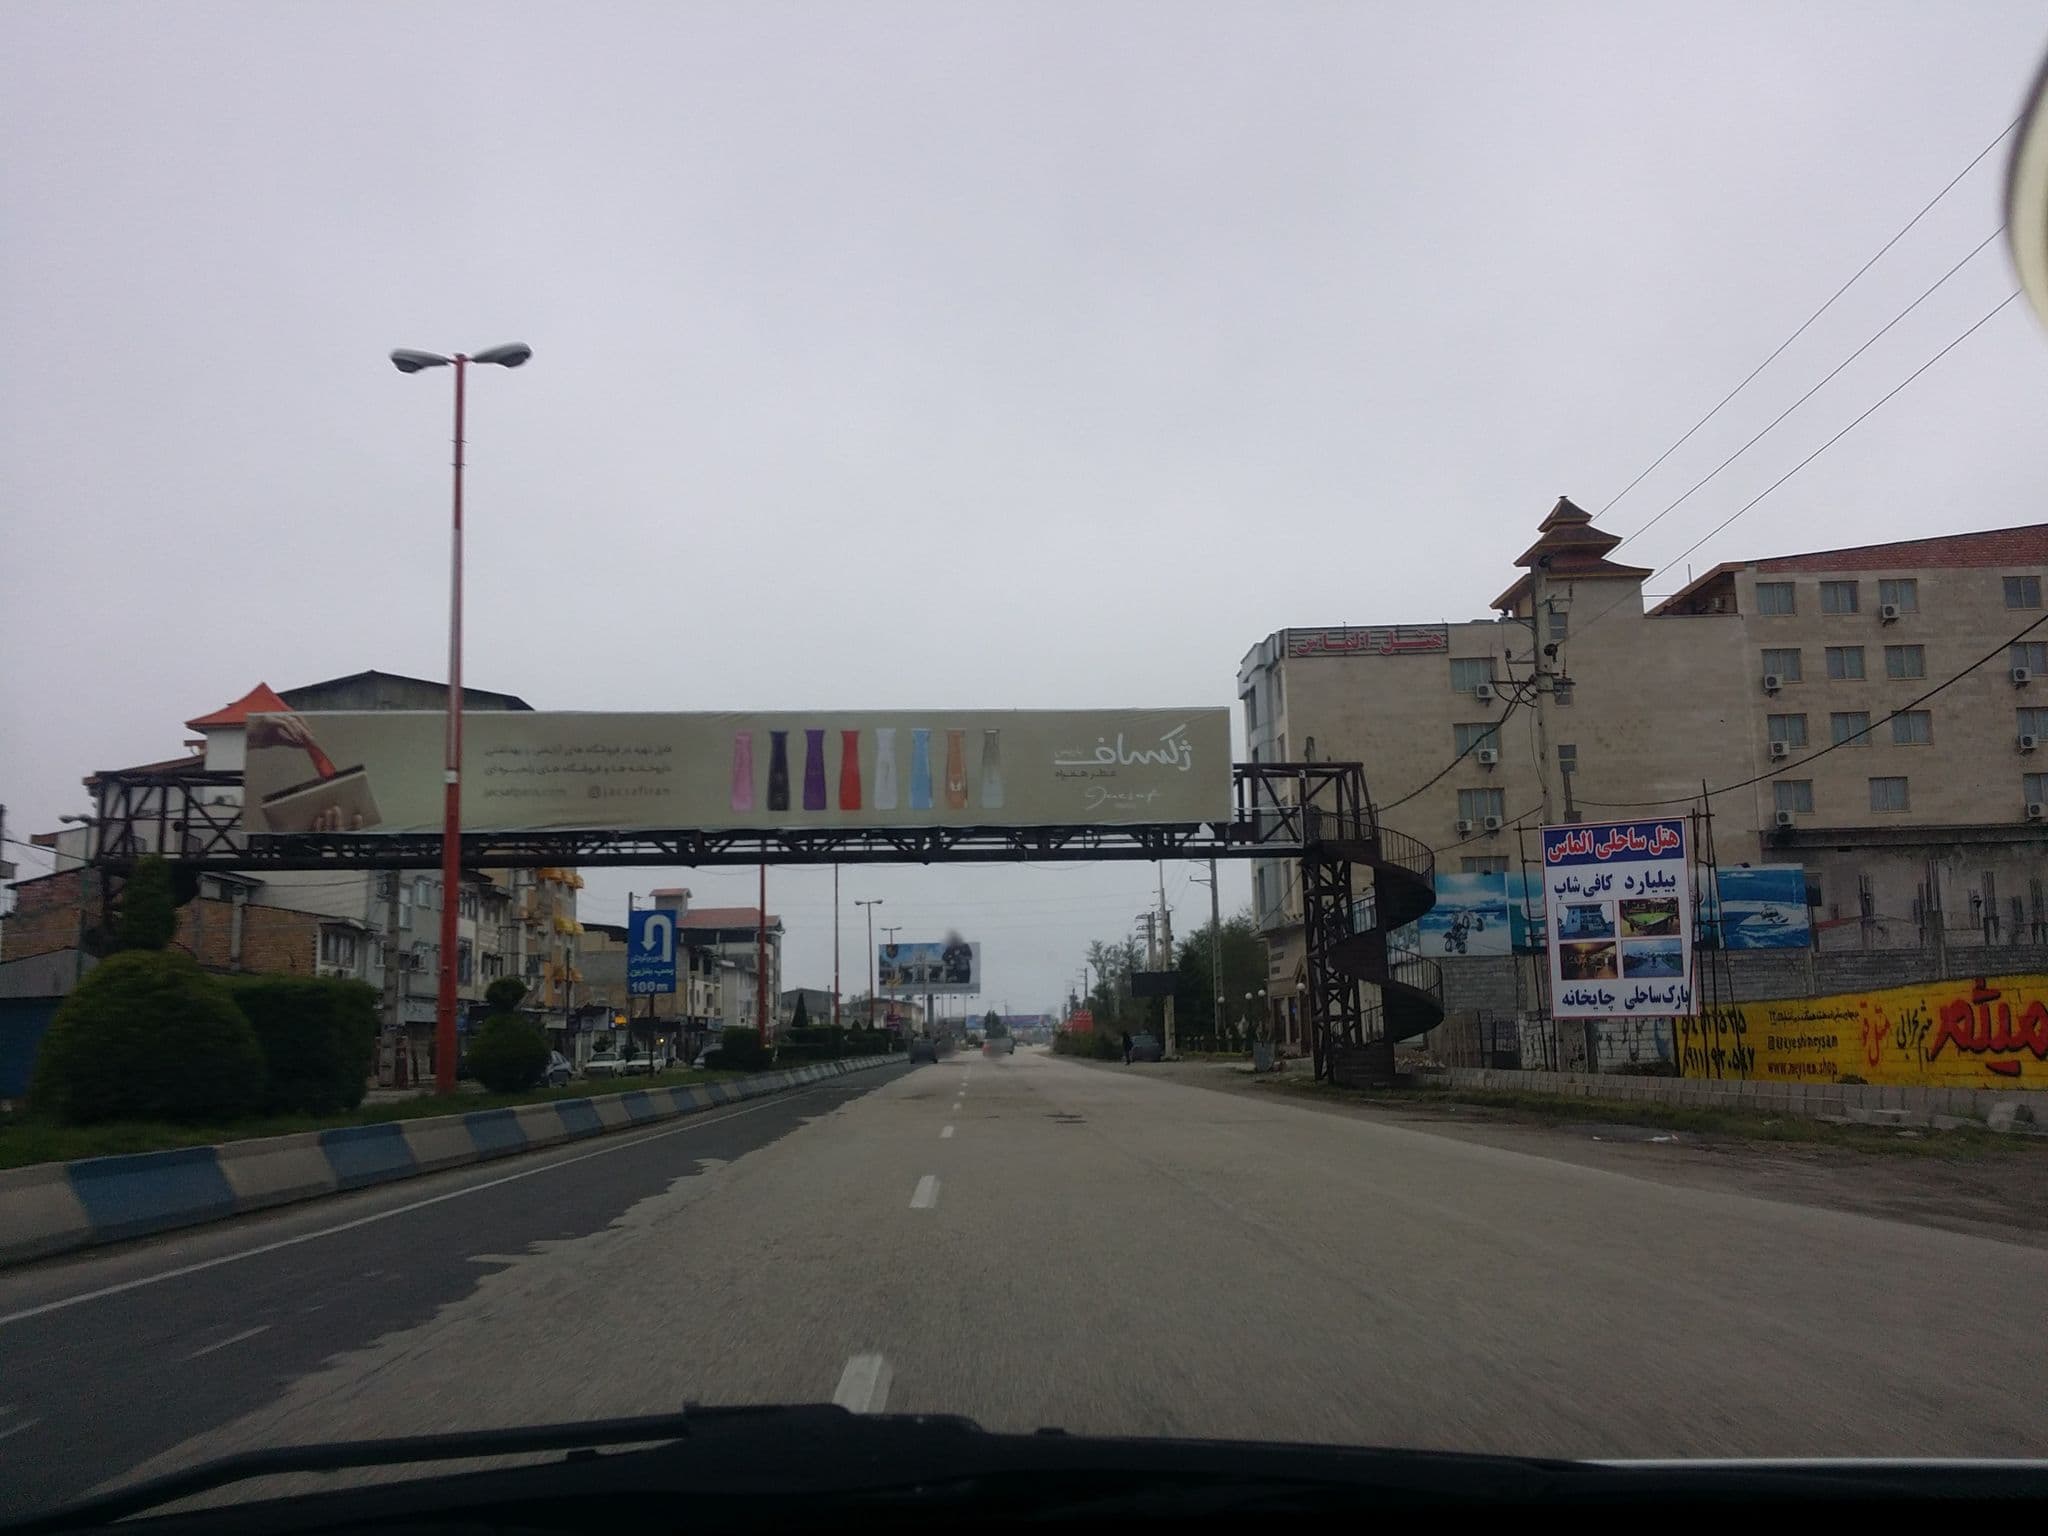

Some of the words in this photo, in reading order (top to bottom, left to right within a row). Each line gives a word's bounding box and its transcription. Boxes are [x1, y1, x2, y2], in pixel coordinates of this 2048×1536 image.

[1296, 631, 1371, 655] الماس
[1380, 629, 1443, 654] هتل
[1548, 829, 1593, 863] الماس
[1596, 827, 1647, 859] ساحلی
[1649, 824, 1680, 855] هتل
[1554, 876, 1580, 900] شاپ
[1583, 873, 1613, 897] کافی
[1624, 869, 1677, 895] بیلیارد
[1562, 987, 1616, 1011] چایخانه
[1624, 985, 1661, 1009] ساحلی
